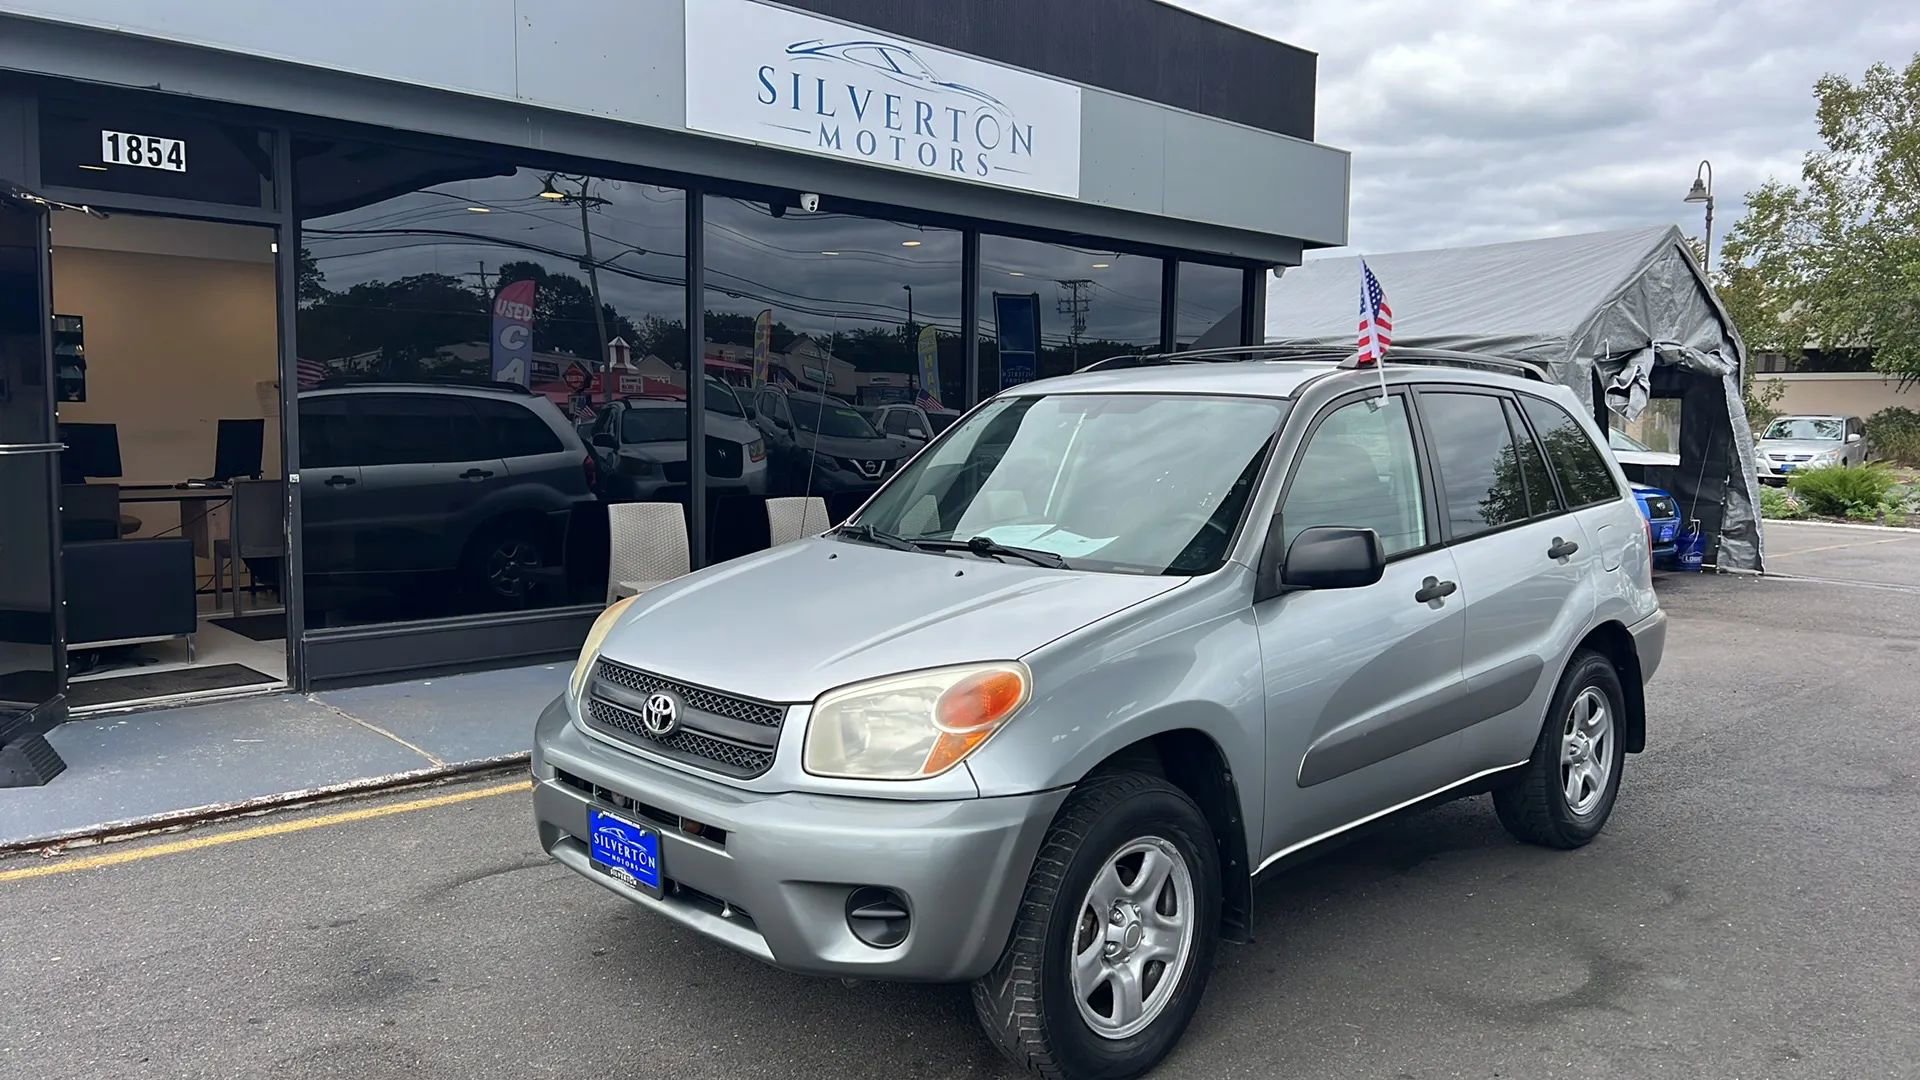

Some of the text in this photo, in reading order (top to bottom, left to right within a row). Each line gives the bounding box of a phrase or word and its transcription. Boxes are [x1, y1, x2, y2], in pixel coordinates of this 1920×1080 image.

[757, 65, 1033, 158] SILVERTON
[107, 133, 183, 170] 1854
[818, 121, 990, 177] MOTORS
[495, 299, 533, 322] USED
[593, 832, 656, 869] SILVERTON
[611, 854, 639, 871] MOTORS
